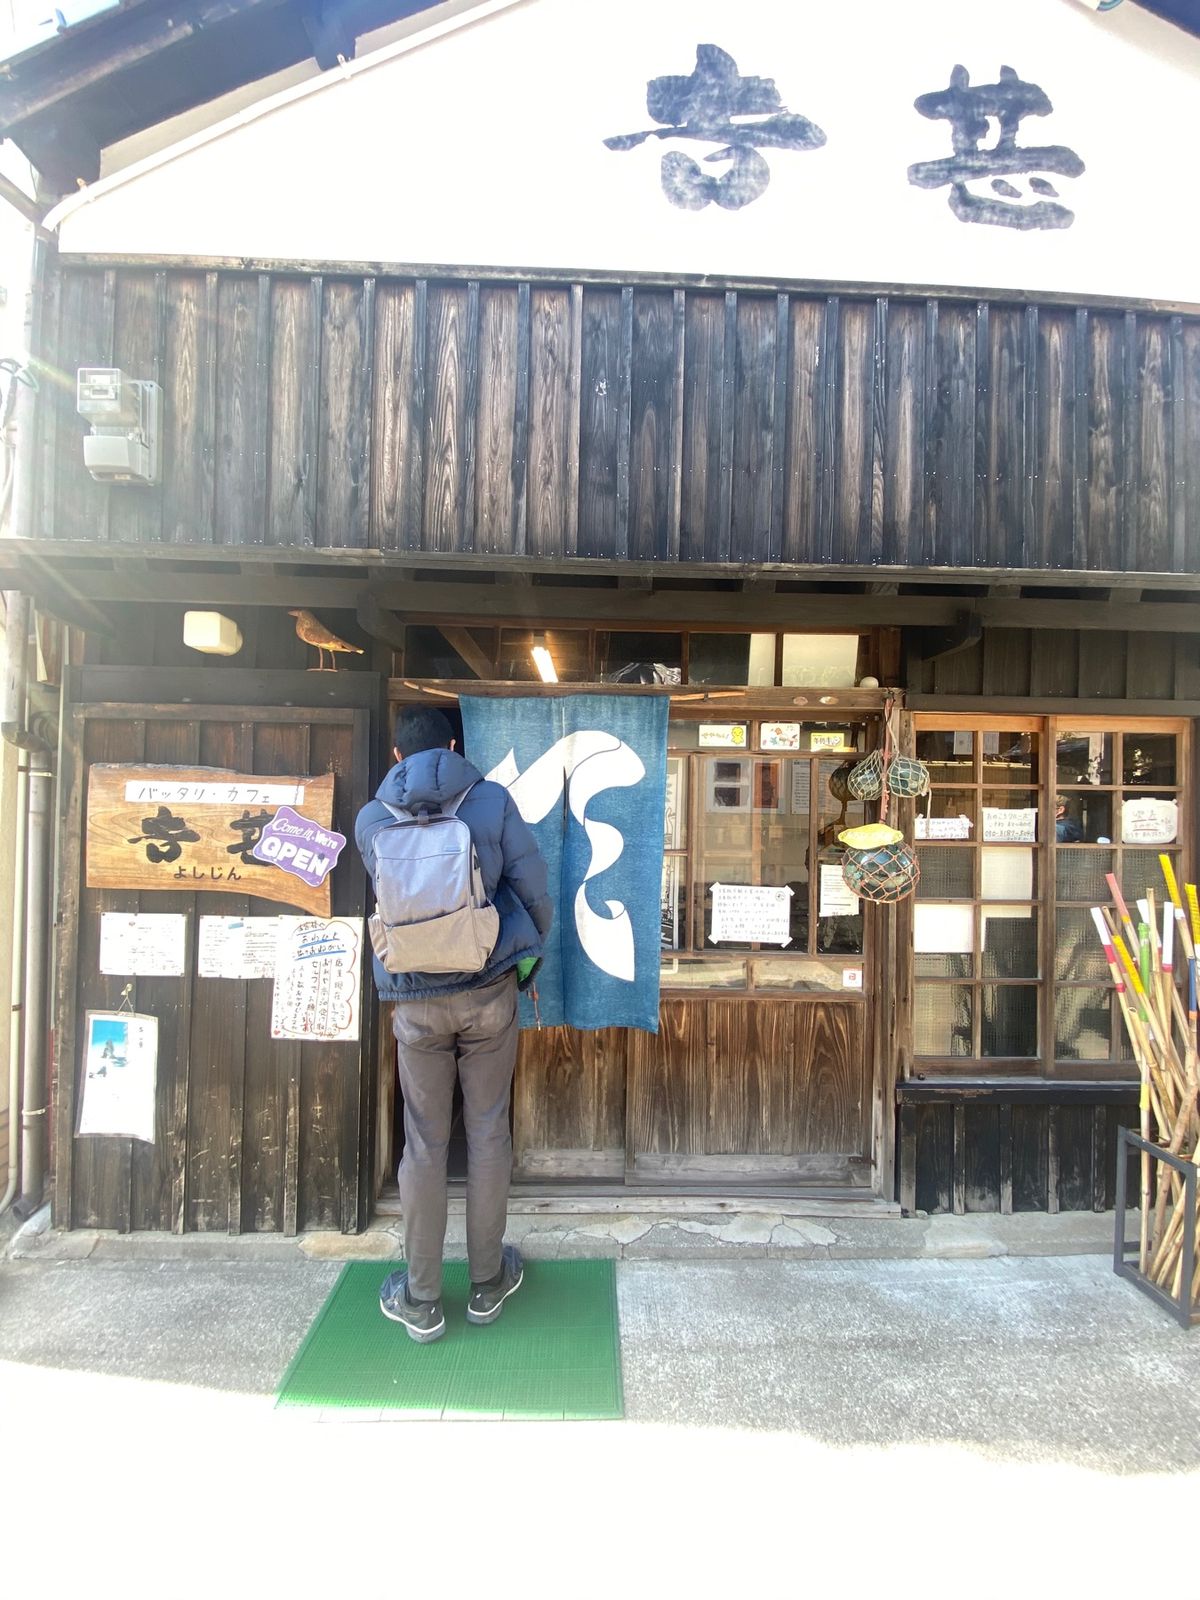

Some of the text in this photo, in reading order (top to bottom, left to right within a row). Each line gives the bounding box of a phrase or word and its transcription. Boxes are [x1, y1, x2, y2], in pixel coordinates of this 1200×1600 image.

[138, 786, 271, 804] バッタリ・カフェ
[271, 817, 304, 835] Come
[260, 836, 331, 877] OPEN
[173, 864, 242, 881] よしじん
